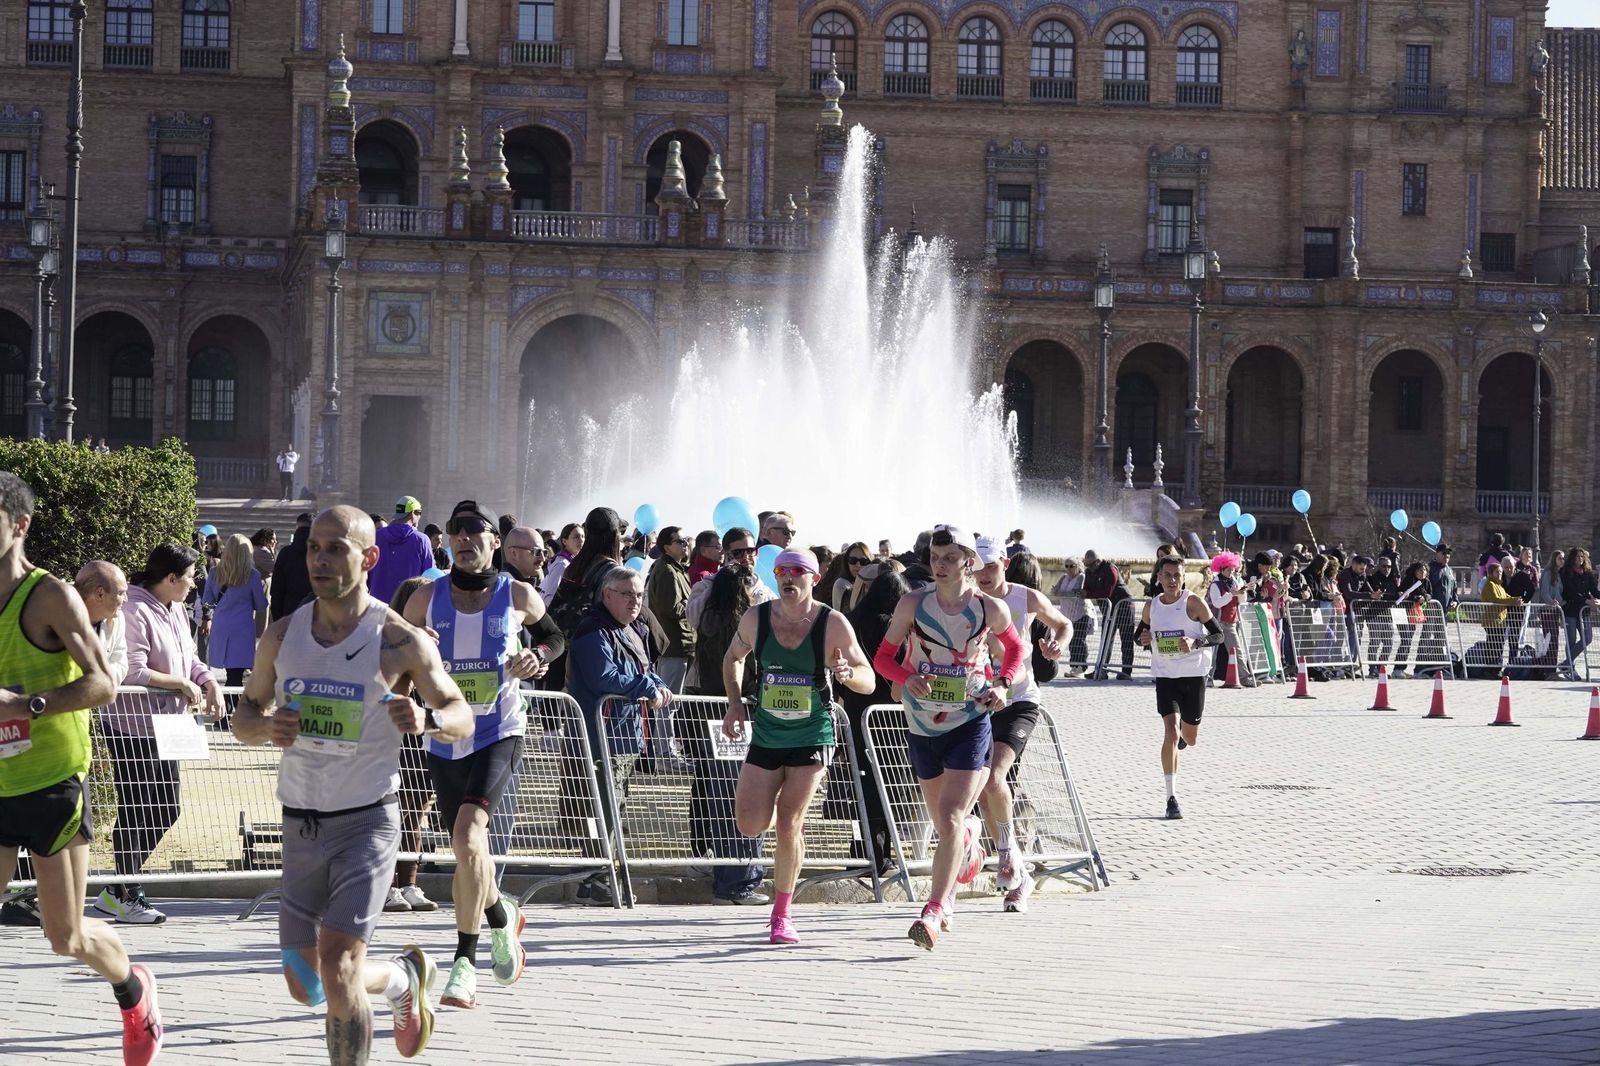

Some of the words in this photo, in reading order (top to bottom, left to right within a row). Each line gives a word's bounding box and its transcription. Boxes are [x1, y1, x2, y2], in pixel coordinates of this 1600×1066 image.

[455, 661, 490, 671] ZURICH
[933, 667, 962, 676] ZURICH
[457, 679, 476, 688] 2078
[777, 676, 806, 684] ZURICH
[310, 684, 355, 696] ZURICH
[772, 699, 799, 709] LOUIS
[310, 704, 333, 716] 1625
[300, 719, 344, 736] MAJID
